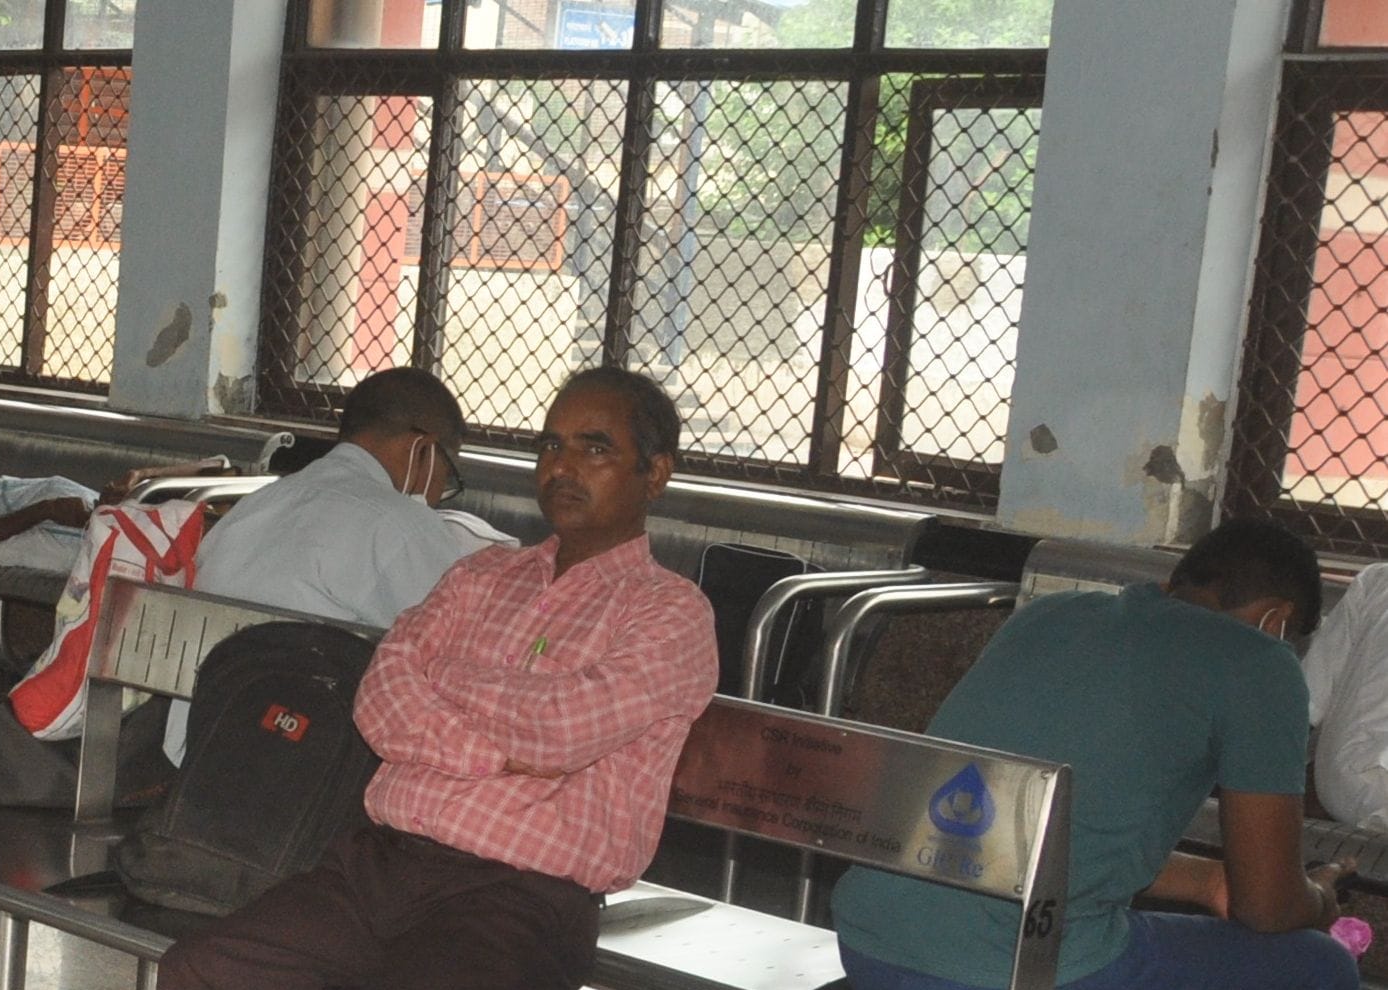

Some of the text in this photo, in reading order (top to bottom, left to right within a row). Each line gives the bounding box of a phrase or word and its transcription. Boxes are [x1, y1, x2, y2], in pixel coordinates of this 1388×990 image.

[273, 711, 299, 733] HD
[760, 726, 789, 745] CSR
[781, 811, 853, 842] Corporation
[856, 831, 869, 846] of
[870, 834, 903, 854] India
[1025, 900, 1057, 938] 65
